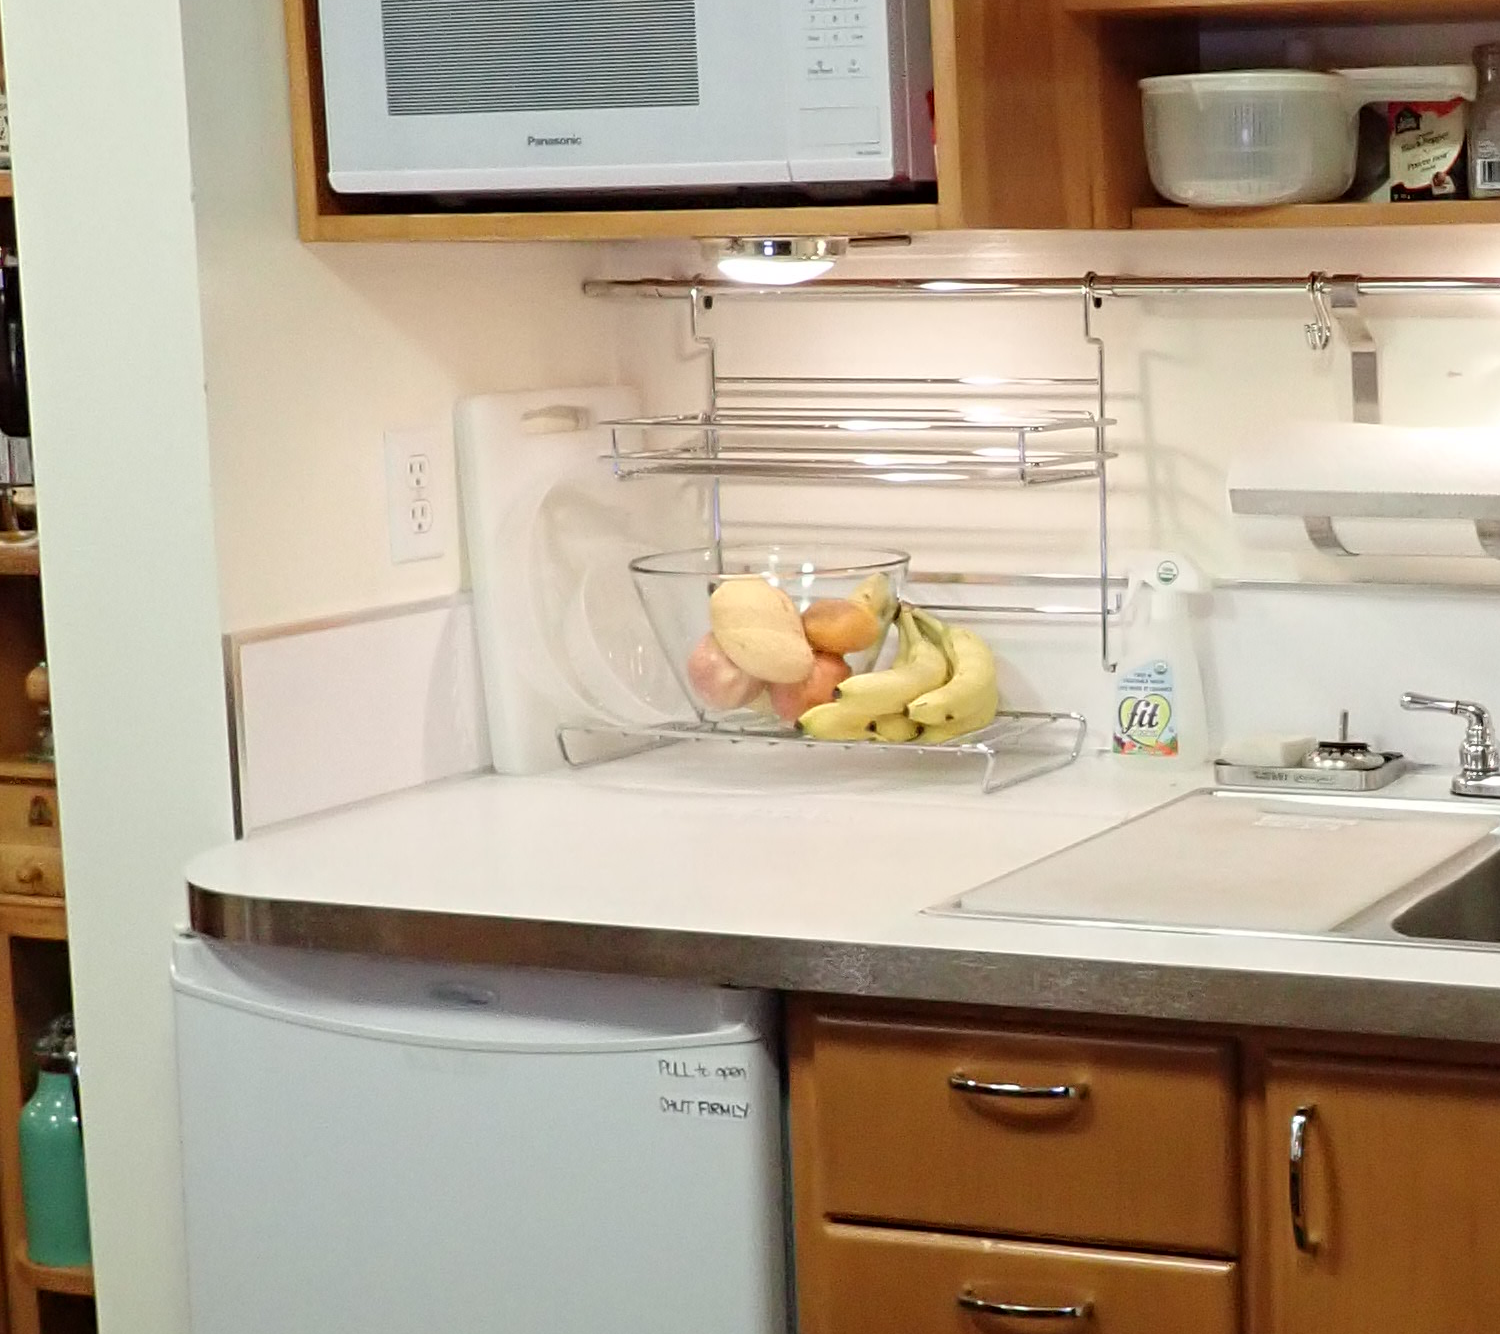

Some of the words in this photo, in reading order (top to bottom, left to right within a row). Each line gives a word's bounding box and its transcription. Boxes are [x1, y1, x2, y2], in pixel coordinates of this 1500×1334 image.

[527, 134, 582, 146] Panasonic
[1121, 699, 1160, 734] fit
[659, 1059, 695, 1078] PULL
[695, 1062, 710, 1077] to
[716, 1066, 747, 1080] open
[660, 1096, 695, 1114] SHUT
[698, 1101, 749, 1119] FIRMLY
